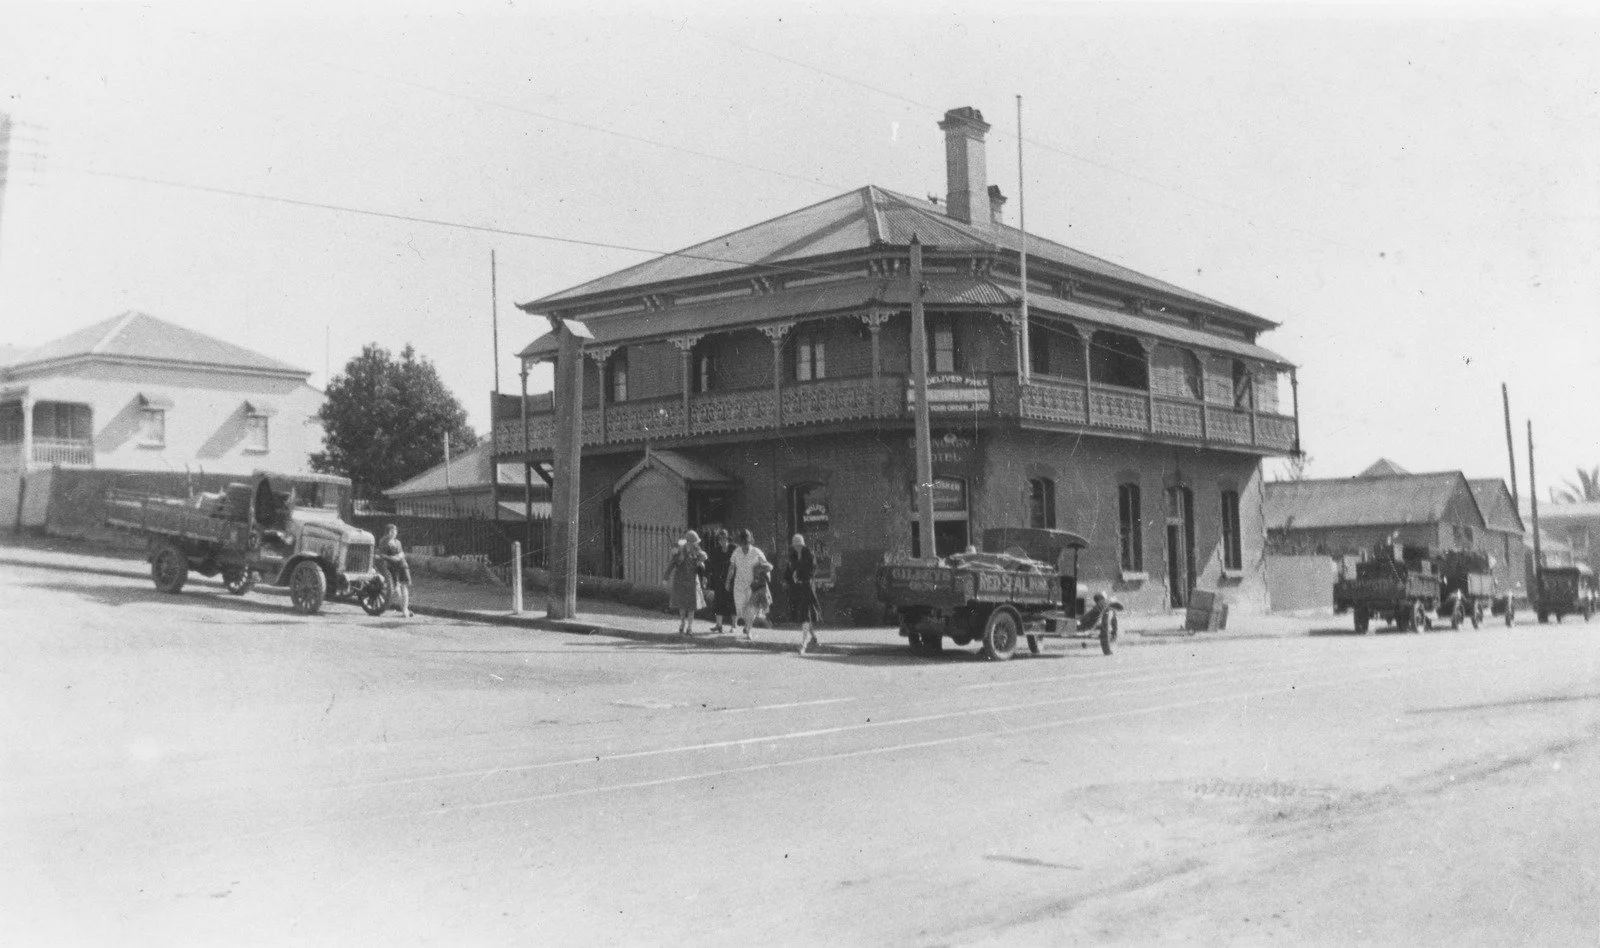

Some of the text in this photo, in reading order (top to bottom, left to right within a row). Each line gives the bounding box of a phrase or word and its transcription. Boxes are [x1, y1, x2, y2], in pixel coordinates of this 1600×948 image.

[927, 375, 962, 386] DELIVER
[909, 437, 971, 449] BNDRY
[931, 453, 961, 462] OTEL
[979, 570, 1001, 592] RED
